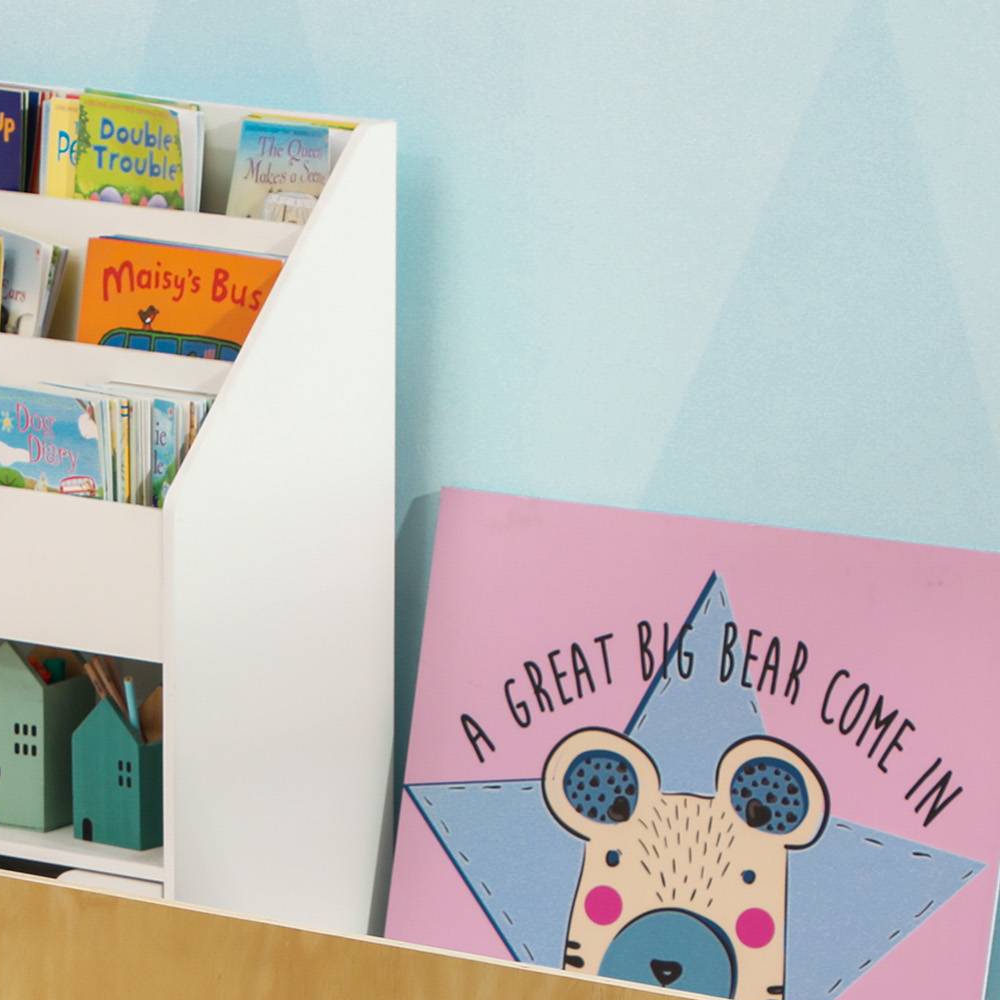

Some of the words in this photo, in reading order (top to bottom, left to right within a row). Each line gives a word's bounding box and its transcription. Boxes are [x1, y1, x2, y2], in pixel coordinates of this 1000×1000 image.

[100, 117, 173, 150] Double
[257, 134, 284, 158] The
[92, 144, 178, 182] Trouble
[102, 259, 201, 303] Maisy's
[211, 267, 263, 311] Bus
[16, 400, 57, 437] Dog
[27, 433, 79, 473] Diary
[460, 713, 496, 764] A
[504, 633, 614, 729] GREAT
[637, 620, 694, 682] BIG
[719, 621, 809, 706] BEAR
[821, 669, 917, 774] COME
[904, 757, 964, 828] IN
